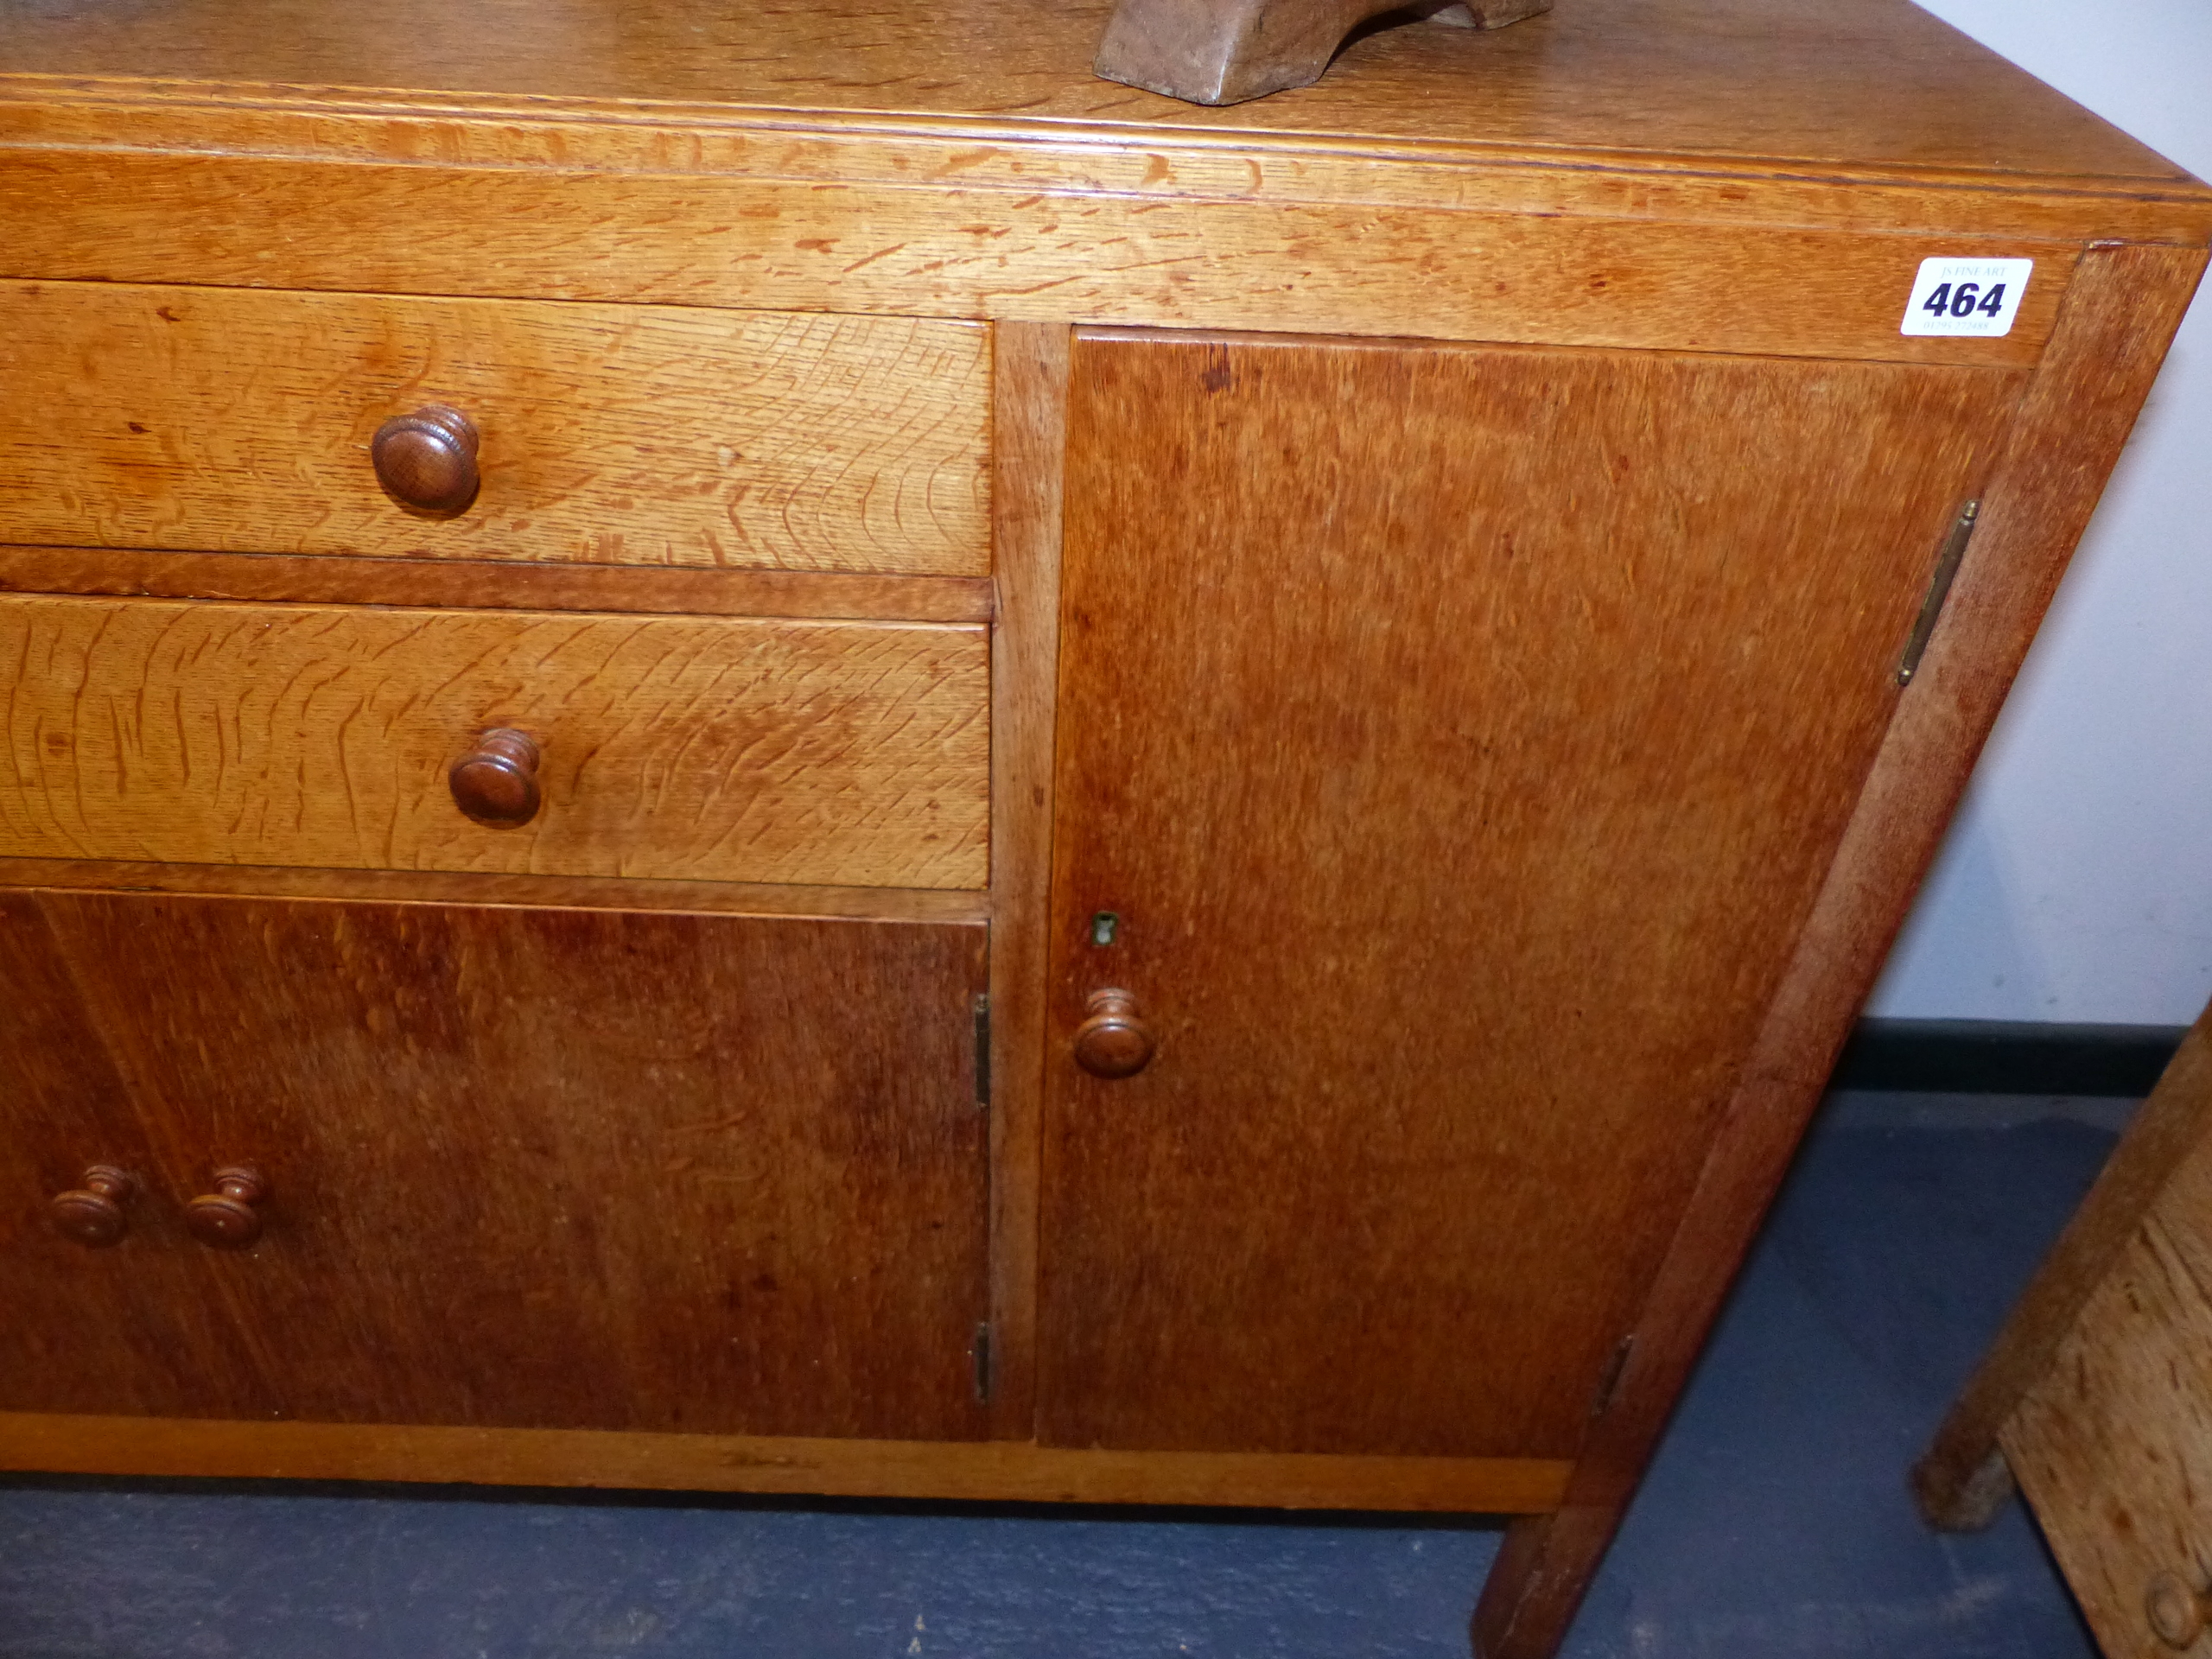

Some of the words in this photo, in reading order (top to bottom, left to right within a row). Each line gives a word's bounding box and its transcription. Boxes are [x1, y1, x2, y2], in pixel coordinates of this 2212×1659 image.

[1955, 266, 1981, 276] FINE
[1983, 266, 2008, 276] ART
[1923, 283, 2006, 318] 464
